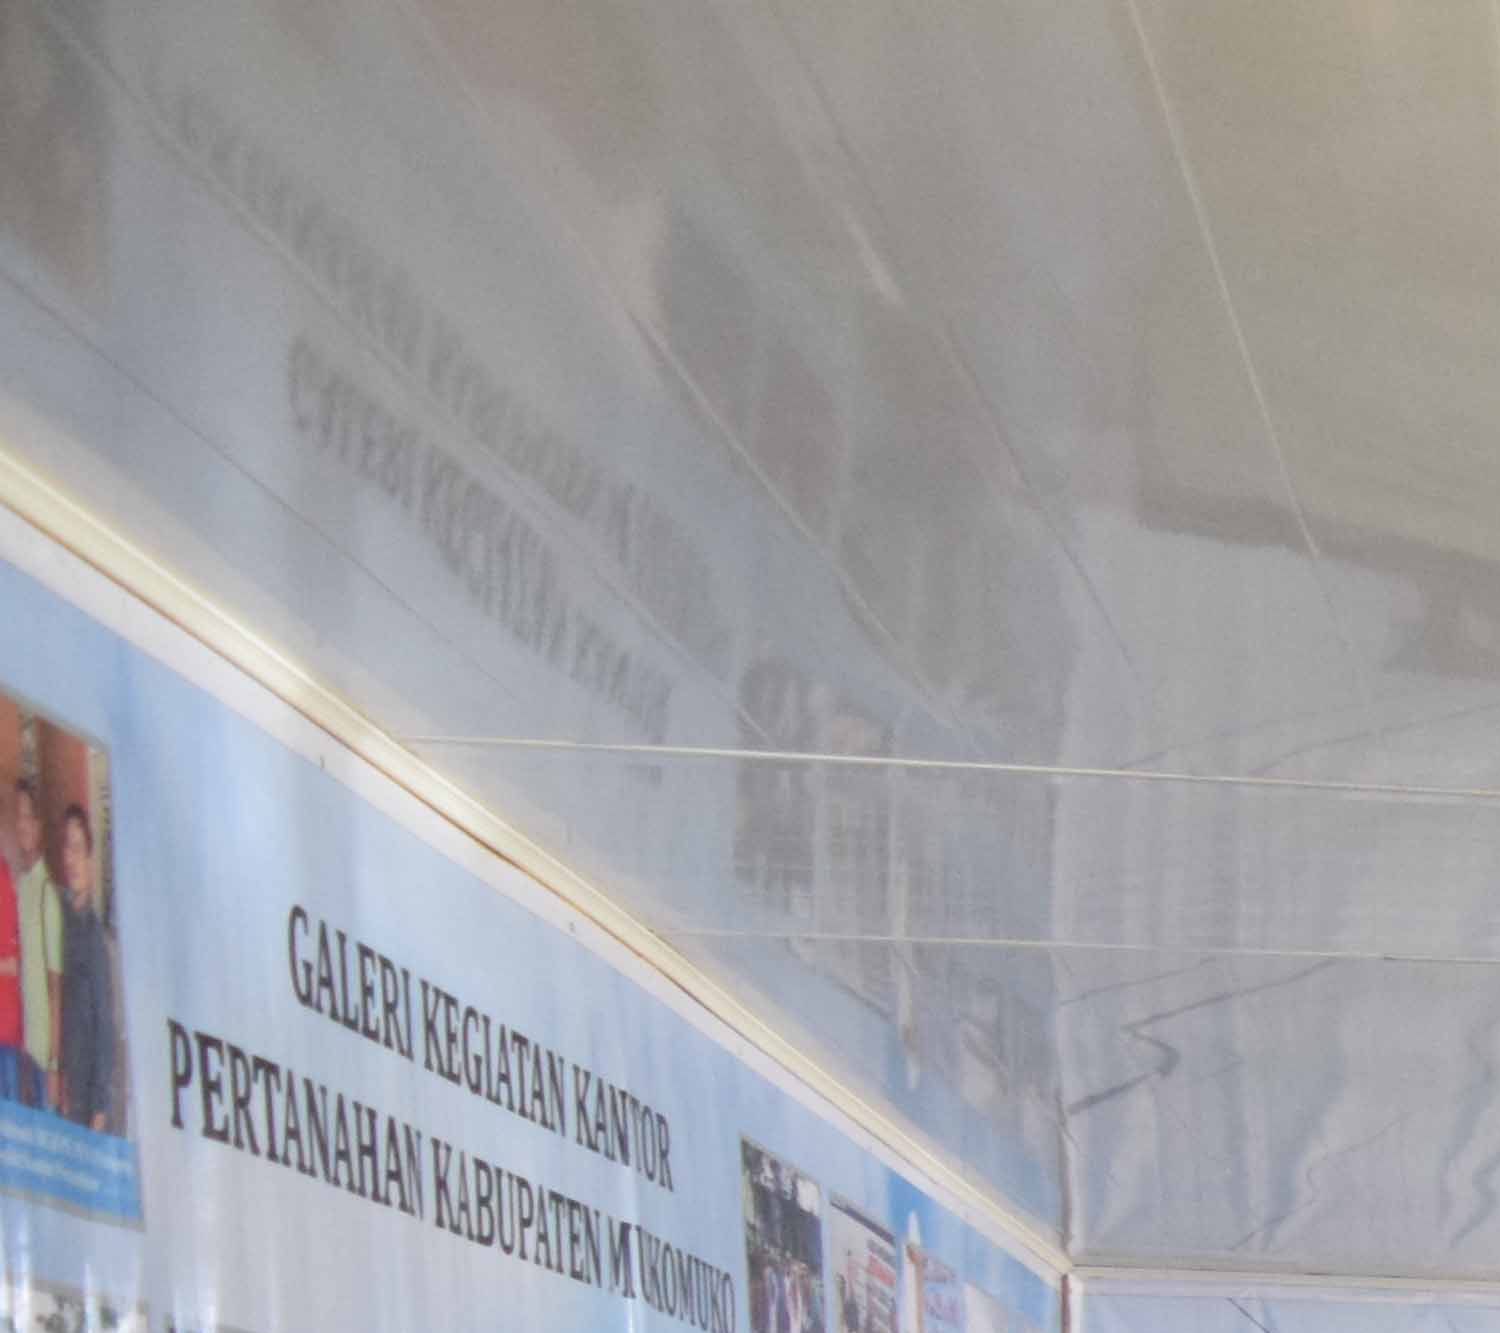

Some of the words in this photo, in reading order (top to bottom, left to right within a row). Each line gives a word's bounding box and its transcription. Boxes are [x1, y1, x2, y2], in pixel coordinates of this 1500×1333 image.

[167, 1017, 424, 1221] PERTANAHAN
[430, 1137, 602, 1288] KABUPATEN
[287, 905, 415, 1062] GALERI
[420, 978, 566, 1138] KEGIATAN
[573, 1064, 673, 1192] KANTOR
